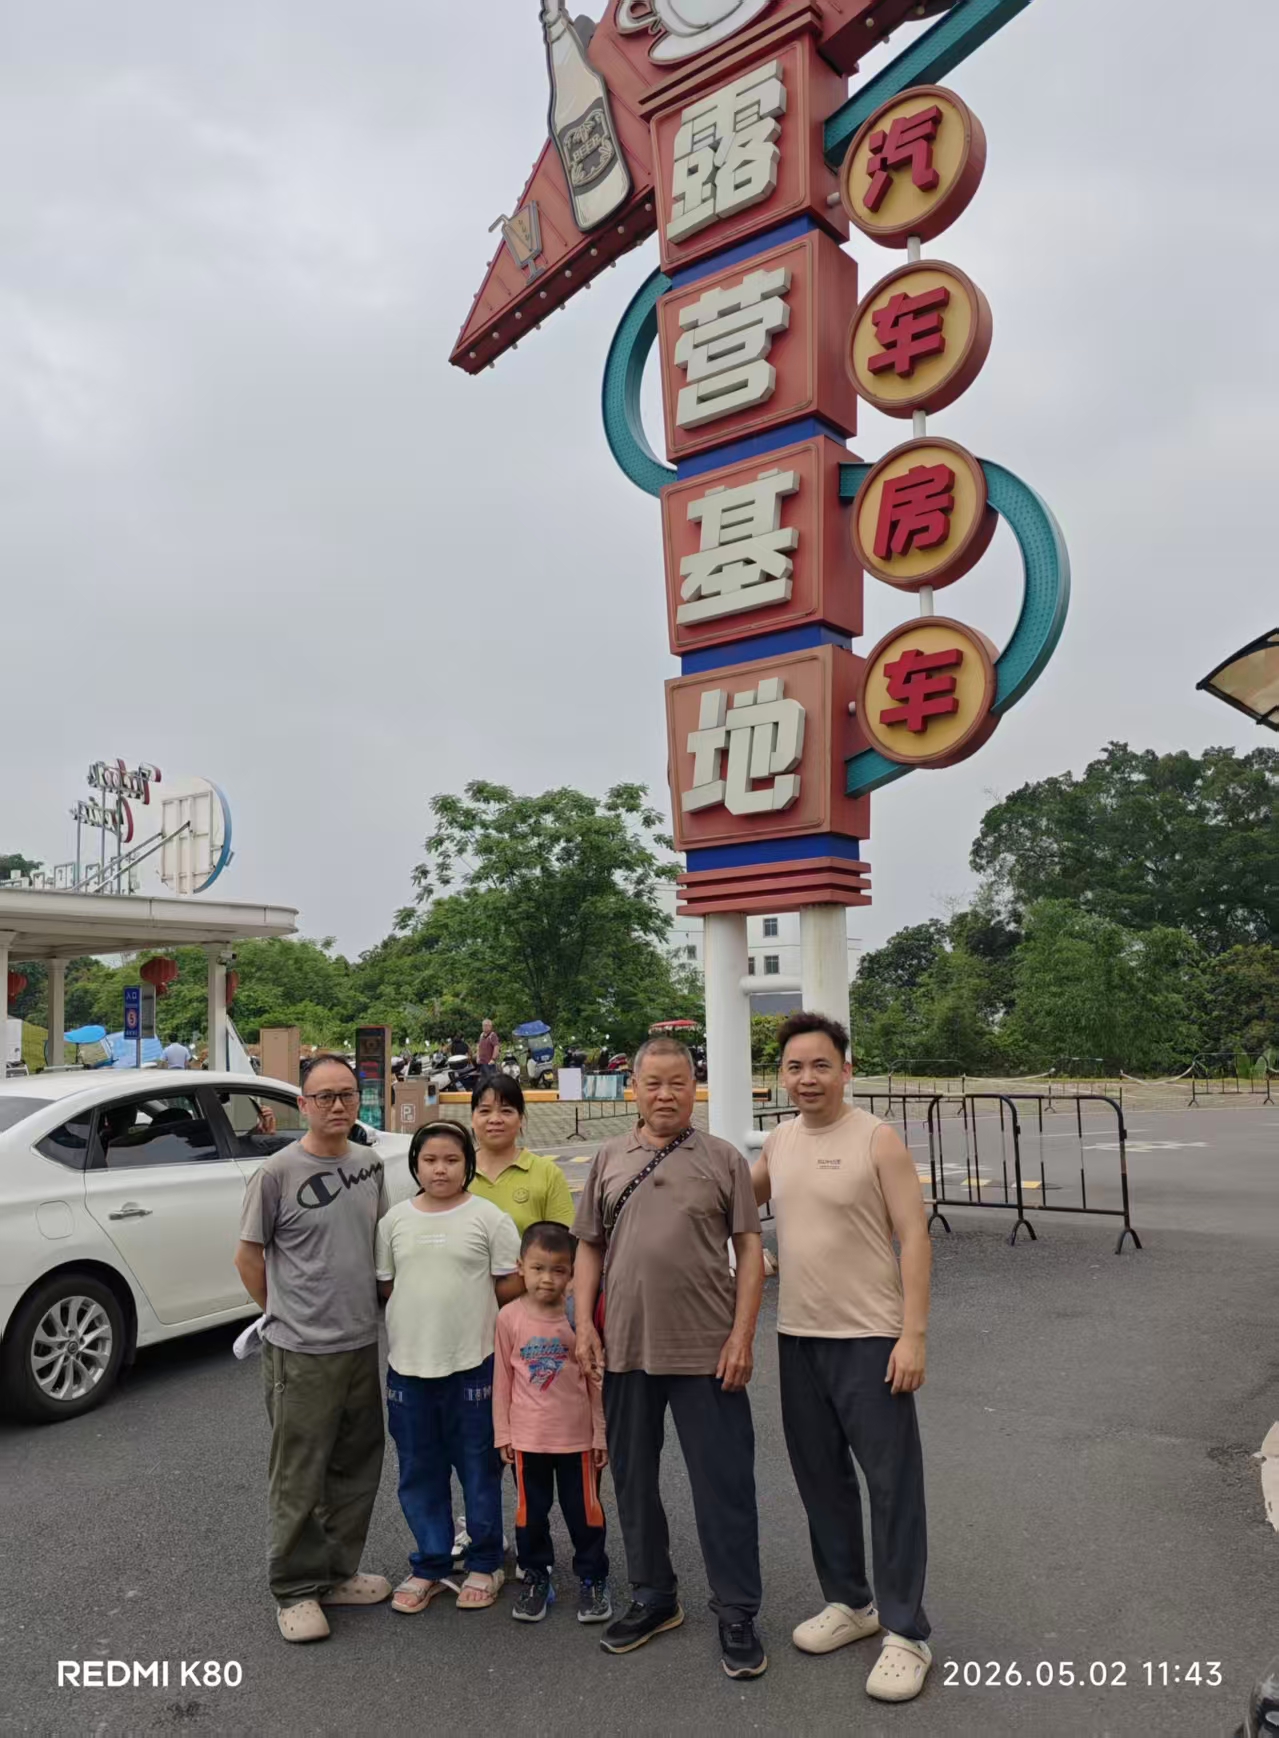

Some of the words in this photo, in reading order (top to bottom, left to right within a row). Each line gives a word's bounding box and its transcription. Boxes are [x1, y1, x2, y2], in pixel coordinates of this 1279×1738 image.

[573, 134, 601, 162] BEER
[667, 60, 805, 815] 露营基地
[863, 106, 962, 733] 汽车房车
